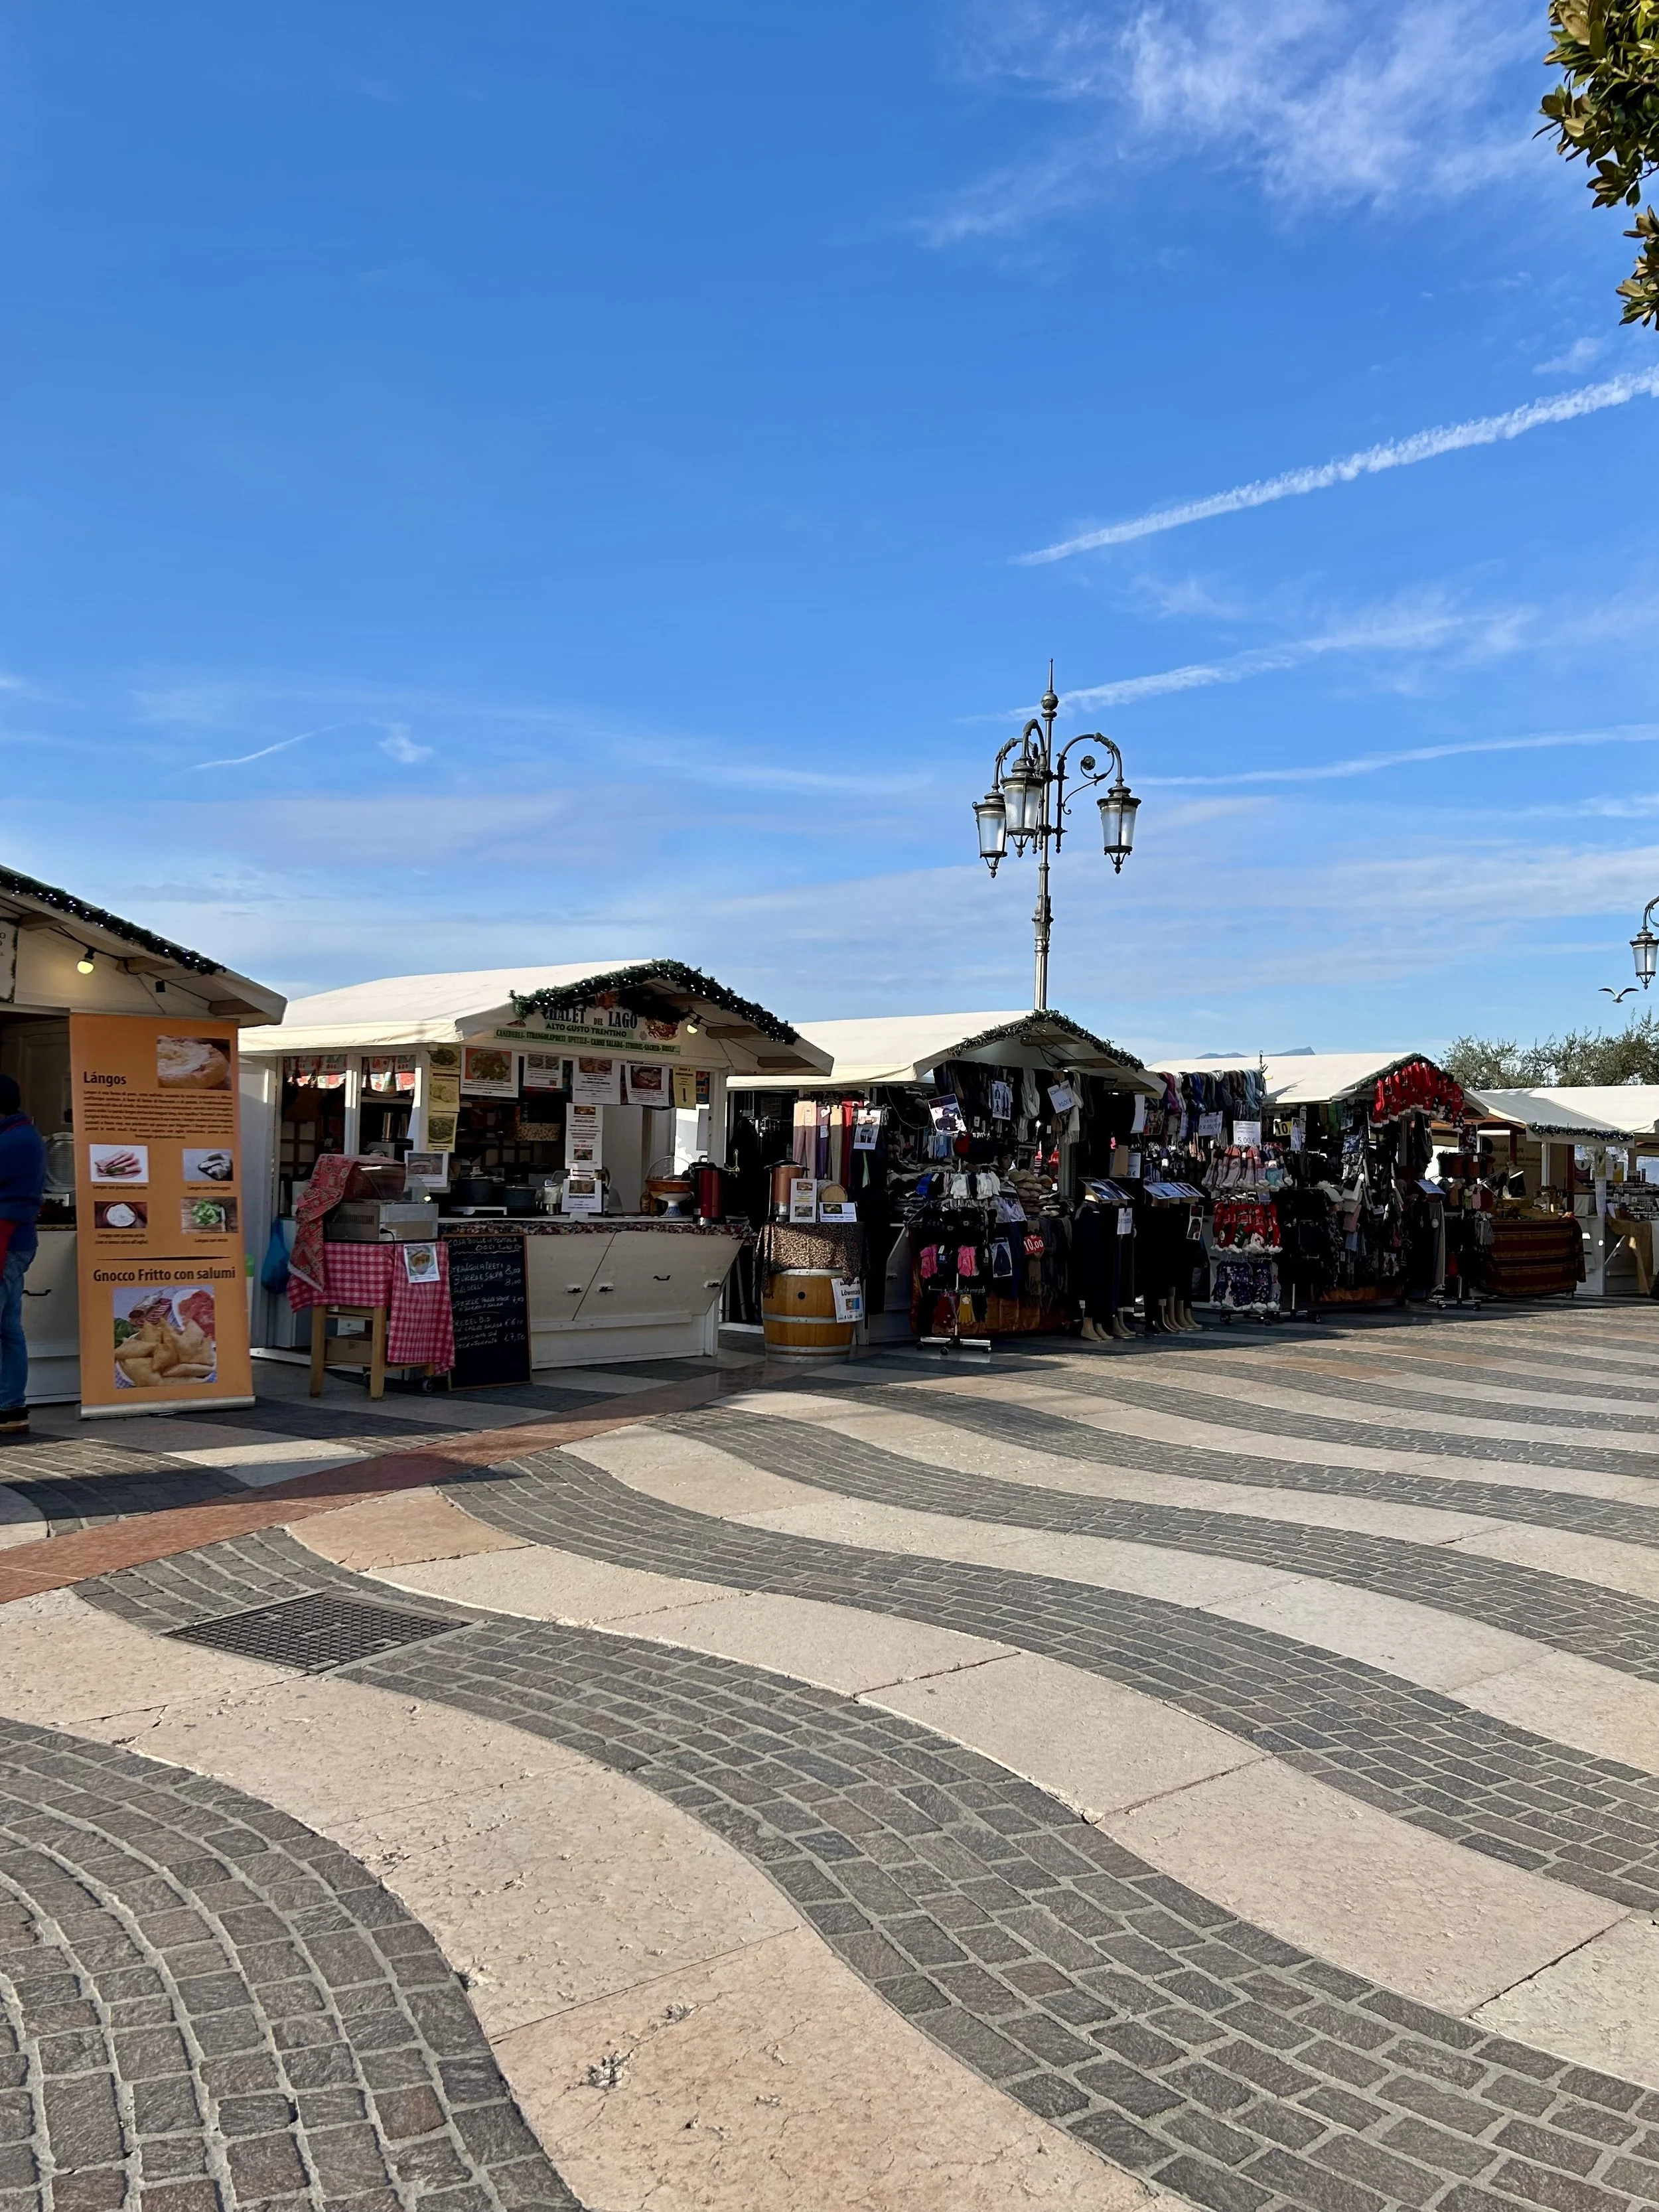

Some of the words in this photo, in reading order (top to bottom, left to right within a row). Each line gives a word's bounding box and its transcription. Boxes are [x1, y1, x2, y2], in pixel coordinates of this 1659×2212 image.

[608, 1010, 638, 1029] LAGO
[566, 1024, 590, 1033] GUSTO
[591, 1027, 627, 1038] TRENTINO
[84, 1071, 127, 1086] Lángos
[1023, 1239, 1044, 1251] 10,00
[93, 1270, 135, 1282] Gnocco
[138, 1268, 171, 1281] Fritto
[174, 1270, 194, 1280] con
[197, 1266, 236, 1280] salumi
